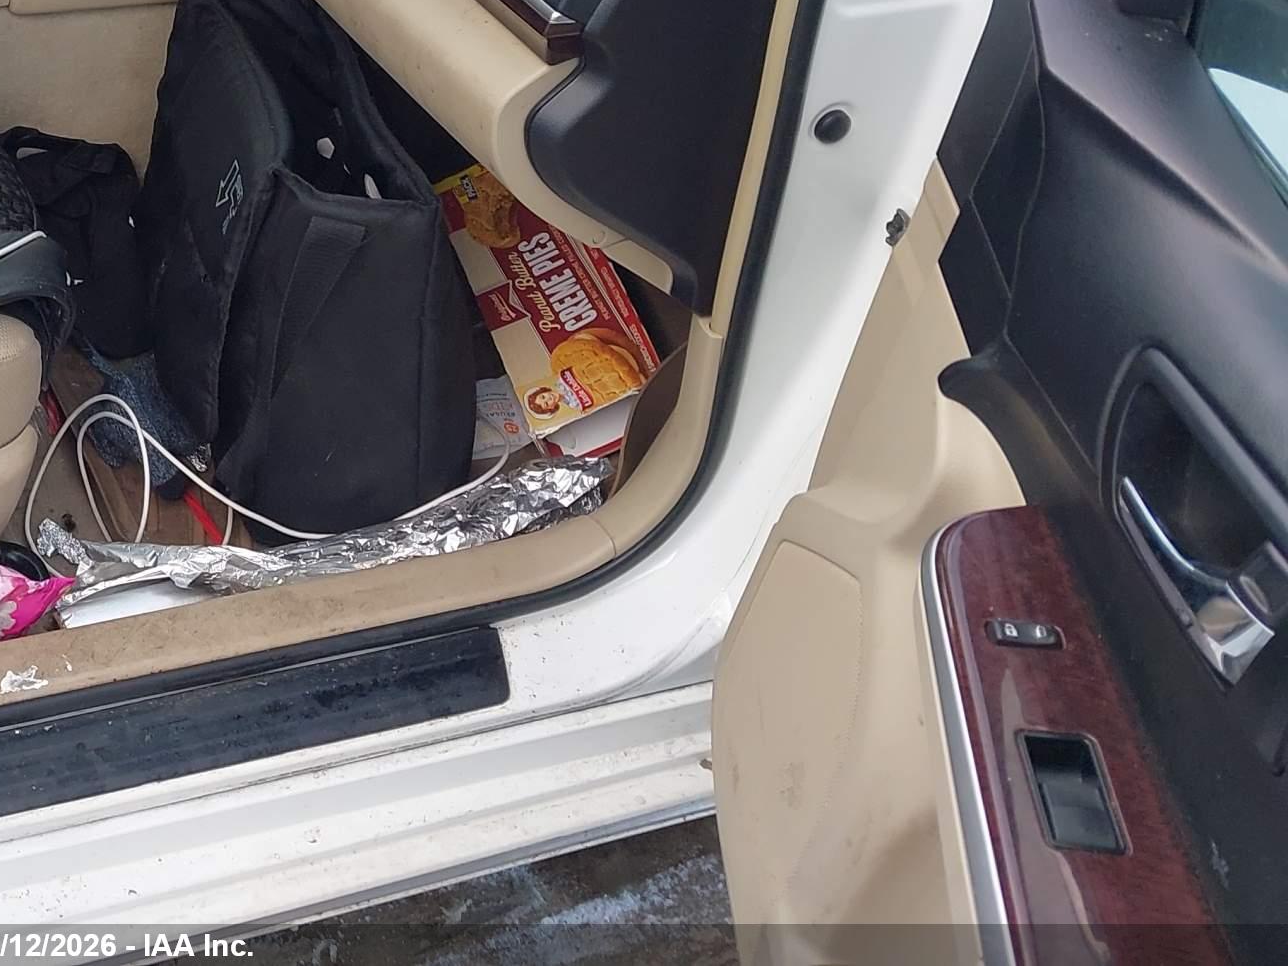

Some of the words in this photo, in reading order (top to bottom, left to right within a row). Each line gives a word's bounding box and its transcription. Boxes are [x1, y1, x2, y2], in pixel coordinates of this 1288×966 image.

[509, 253, 534, 288] Butter
[518, 233, 565, 276] PIES
[527, 290, 560, 332] Peanut
[541, 270, 597, 331] CREME
